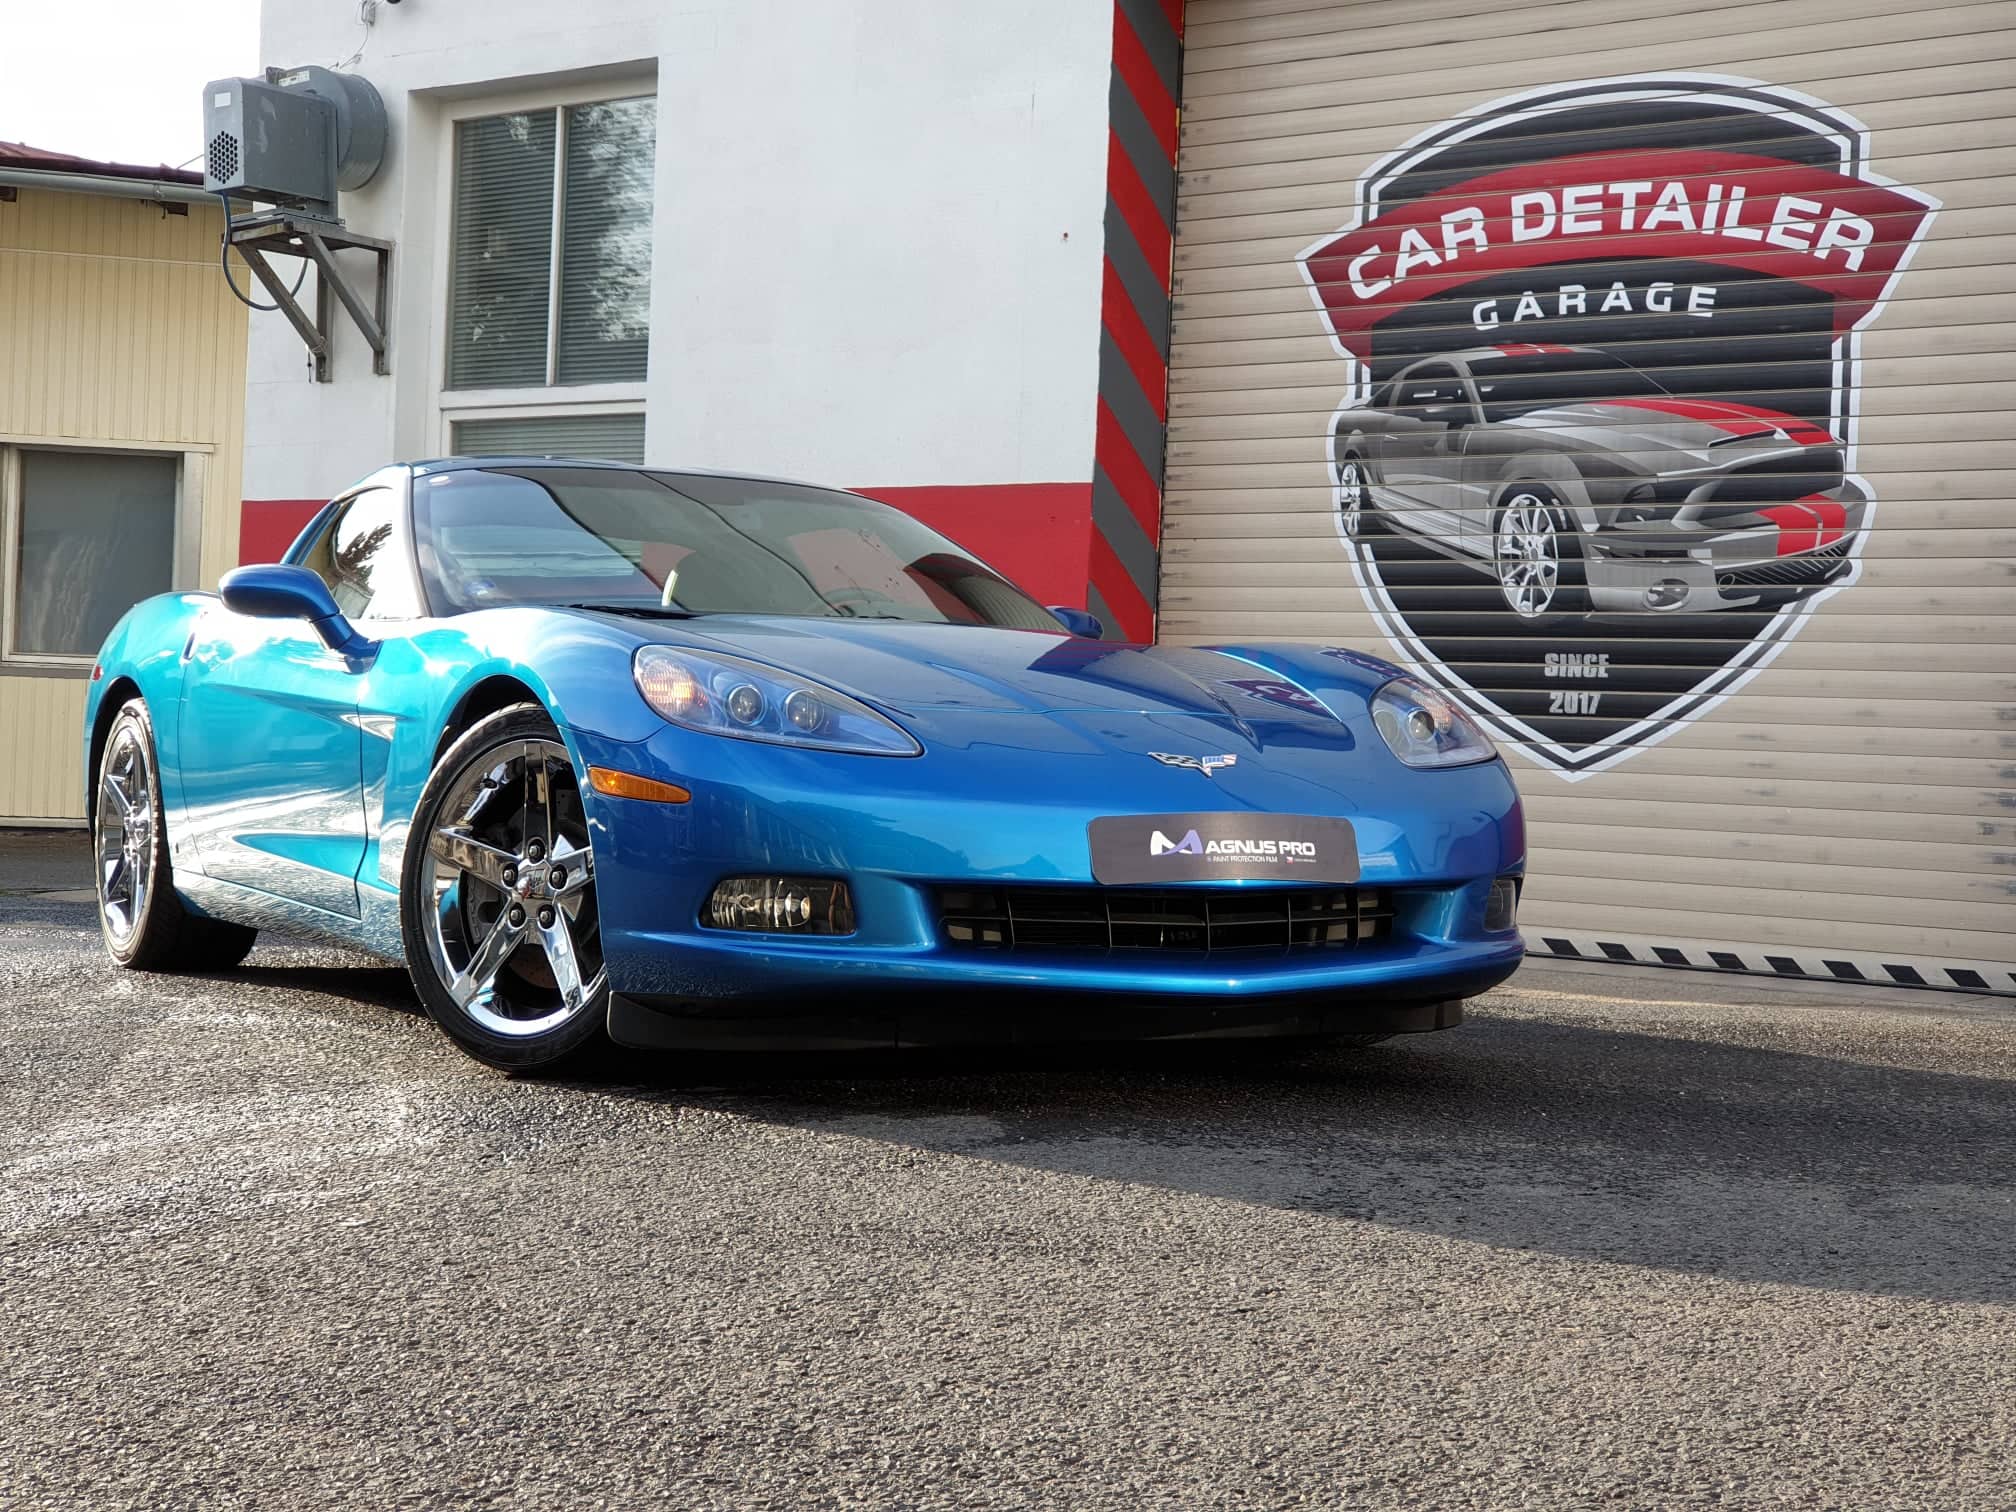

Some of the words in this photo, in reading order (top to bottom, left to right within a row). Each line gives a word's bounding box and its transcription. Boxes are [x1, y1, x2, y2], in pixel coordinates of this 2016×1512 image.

[1348, 206, 1488, 300] CAR
[1511, 181, 1875, 273] DETAILER
[1472, 281, 1718, 331] GARAGE
[1544, 653, 1609, 678] SINCE
[1549, 691, 1601, 715] 2017
[1150, 829, 1277, 856] MAGNUS
[1279, 841, 1316, 857] PRO
[1212, 855, 1229, 863] PAINT
[1230, 855, 1265, 864] PROTECTION
[1266, 856, 1278, 864] FILM
